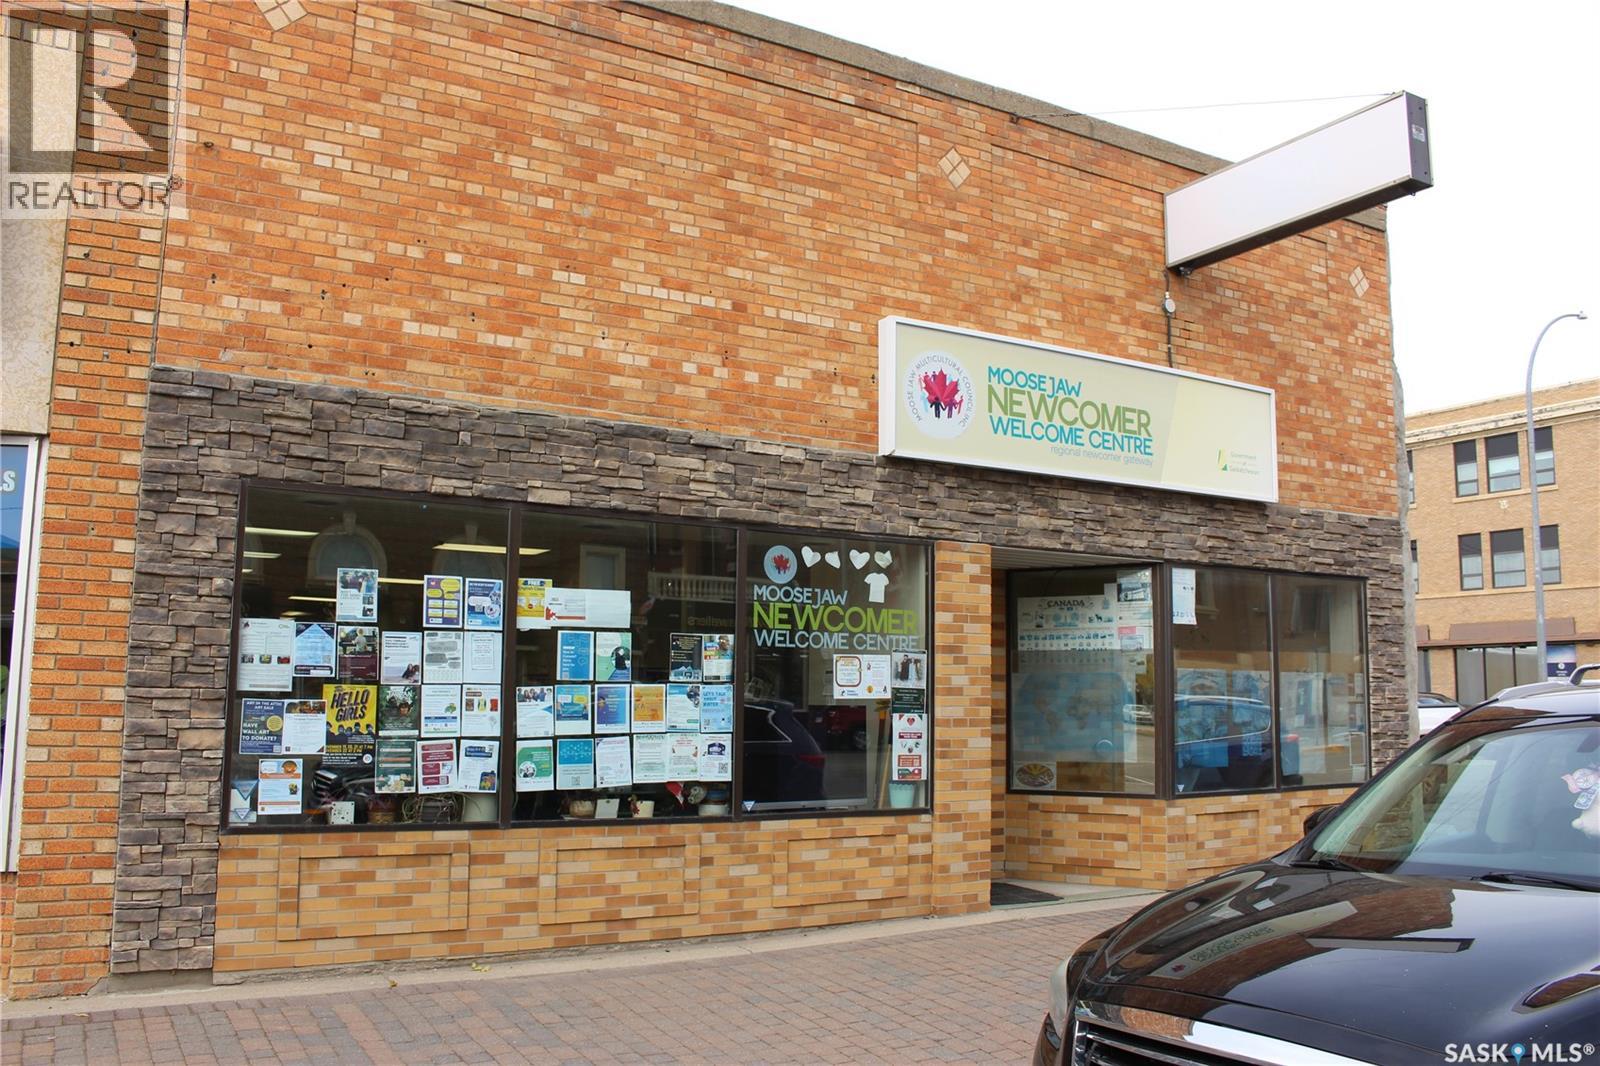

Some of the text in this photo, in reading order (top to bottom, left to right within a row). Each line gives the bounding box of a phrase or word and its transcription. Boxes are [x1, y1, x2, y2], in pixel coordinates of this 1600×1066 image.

[988, 366, 1082, 399] MOOSE JAW
[987, 384, 1153, 437] NEWCOMER
[989, 414, 1153, 456] WELCOME CENTRE
[1050, 446, 1153, 467] regional newcomer gateway
[753, 584, 848, 609] MOOSE JAW
[1046, 599, 1085, 608] CANADA
[752, 601, 919, 635] NEWCOMER
[753, 629, 919, 651] WELCOME CENTRE
[331, 689, 370, 709] HELLO
[335, 704, 367, 722] GIRLS
